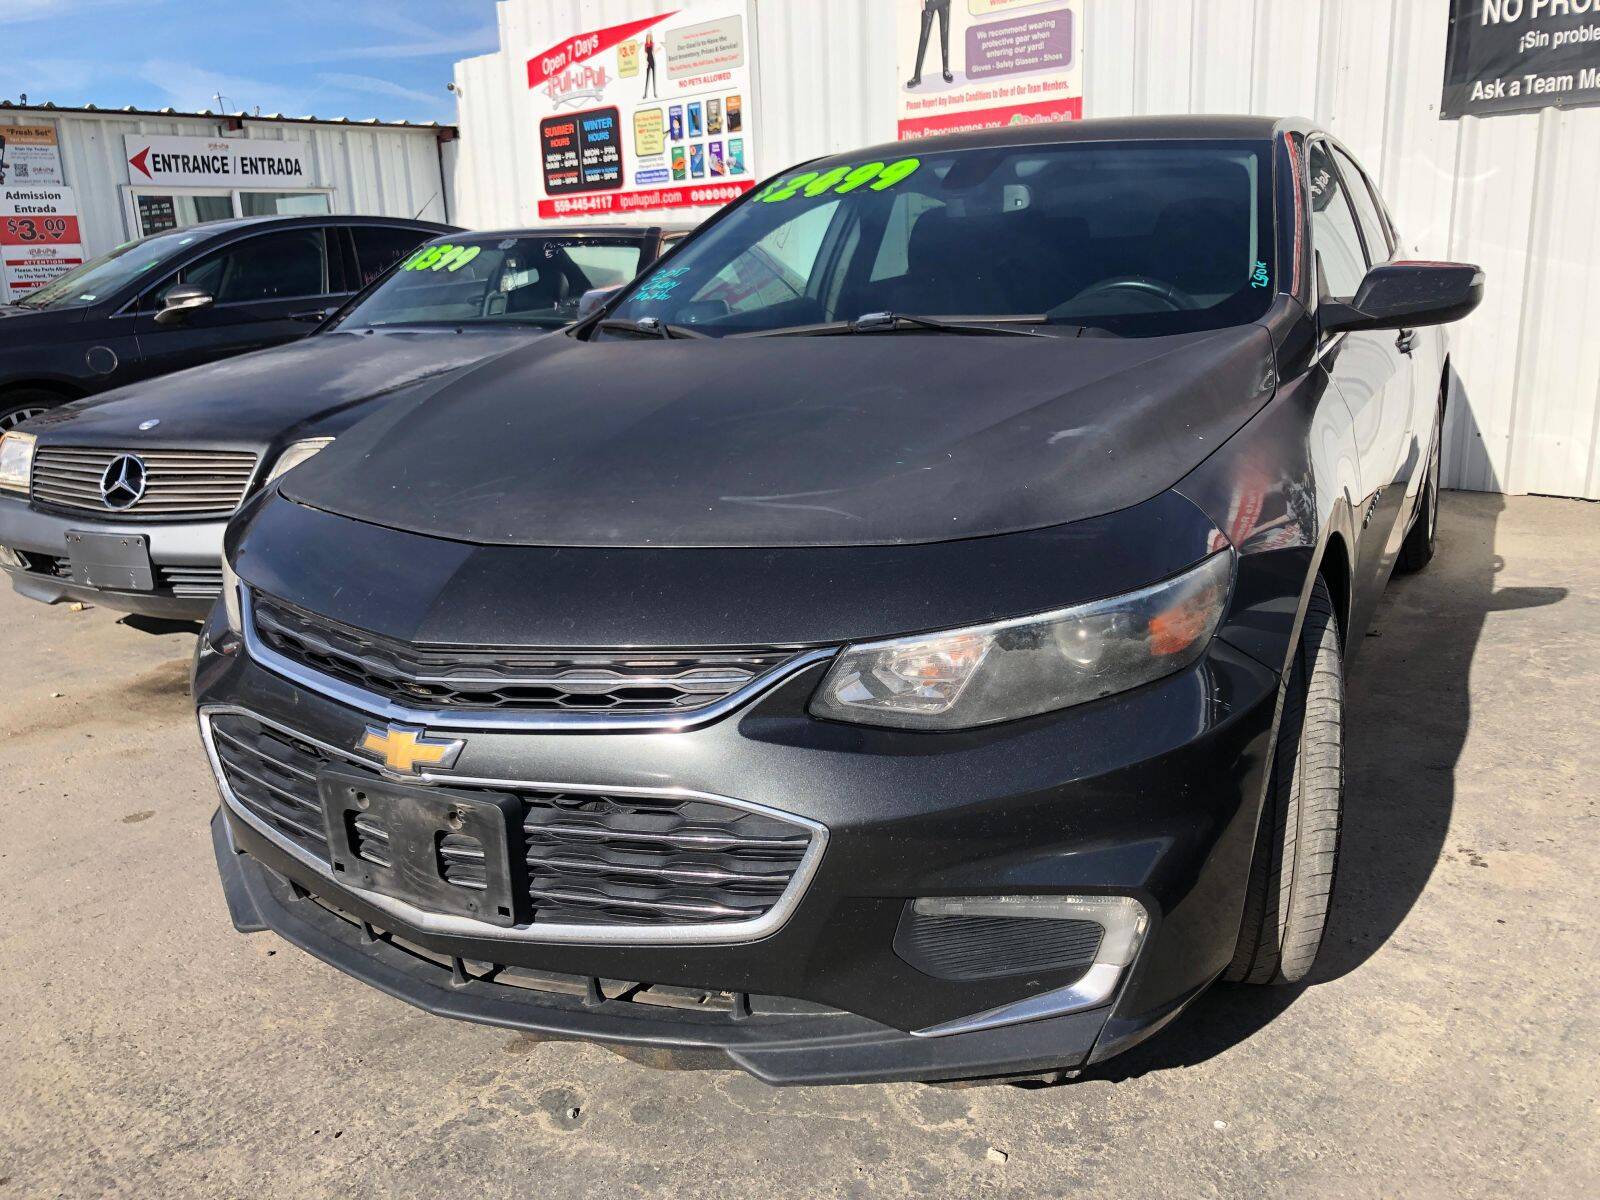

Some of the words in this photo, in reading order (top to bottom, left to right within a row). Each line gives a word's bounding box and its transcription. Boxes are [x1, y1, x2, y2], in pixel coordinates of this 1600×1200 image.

[1481, 0, 1524, 26] NO
[1029, 19, 1056, 30] wearing
[1518, 30, 1549, 53] ¡Sin
[542, 52, 566, 76] Open
[566, 44, 574, 62] 7
[574, 34, 599, 58] Days
[702, 72, 731, 84] ALLOWED
[1470, 78, 1506, 101] Ask
[1508, 80, 1520, 96] a
[1524, 74, 1574, 95] Team
[544, 124, 574, 138] SUMMER
[583, 117, 612, 132] WINTER
[152, 154, 230, 174] ENTRANCE
[240, 157, 302, 176] ENTRADA
[6, 191, 62, 200] Admission
[14, 204, 57, 213] Entrada
[8, 218, 66, 241] $3.00
